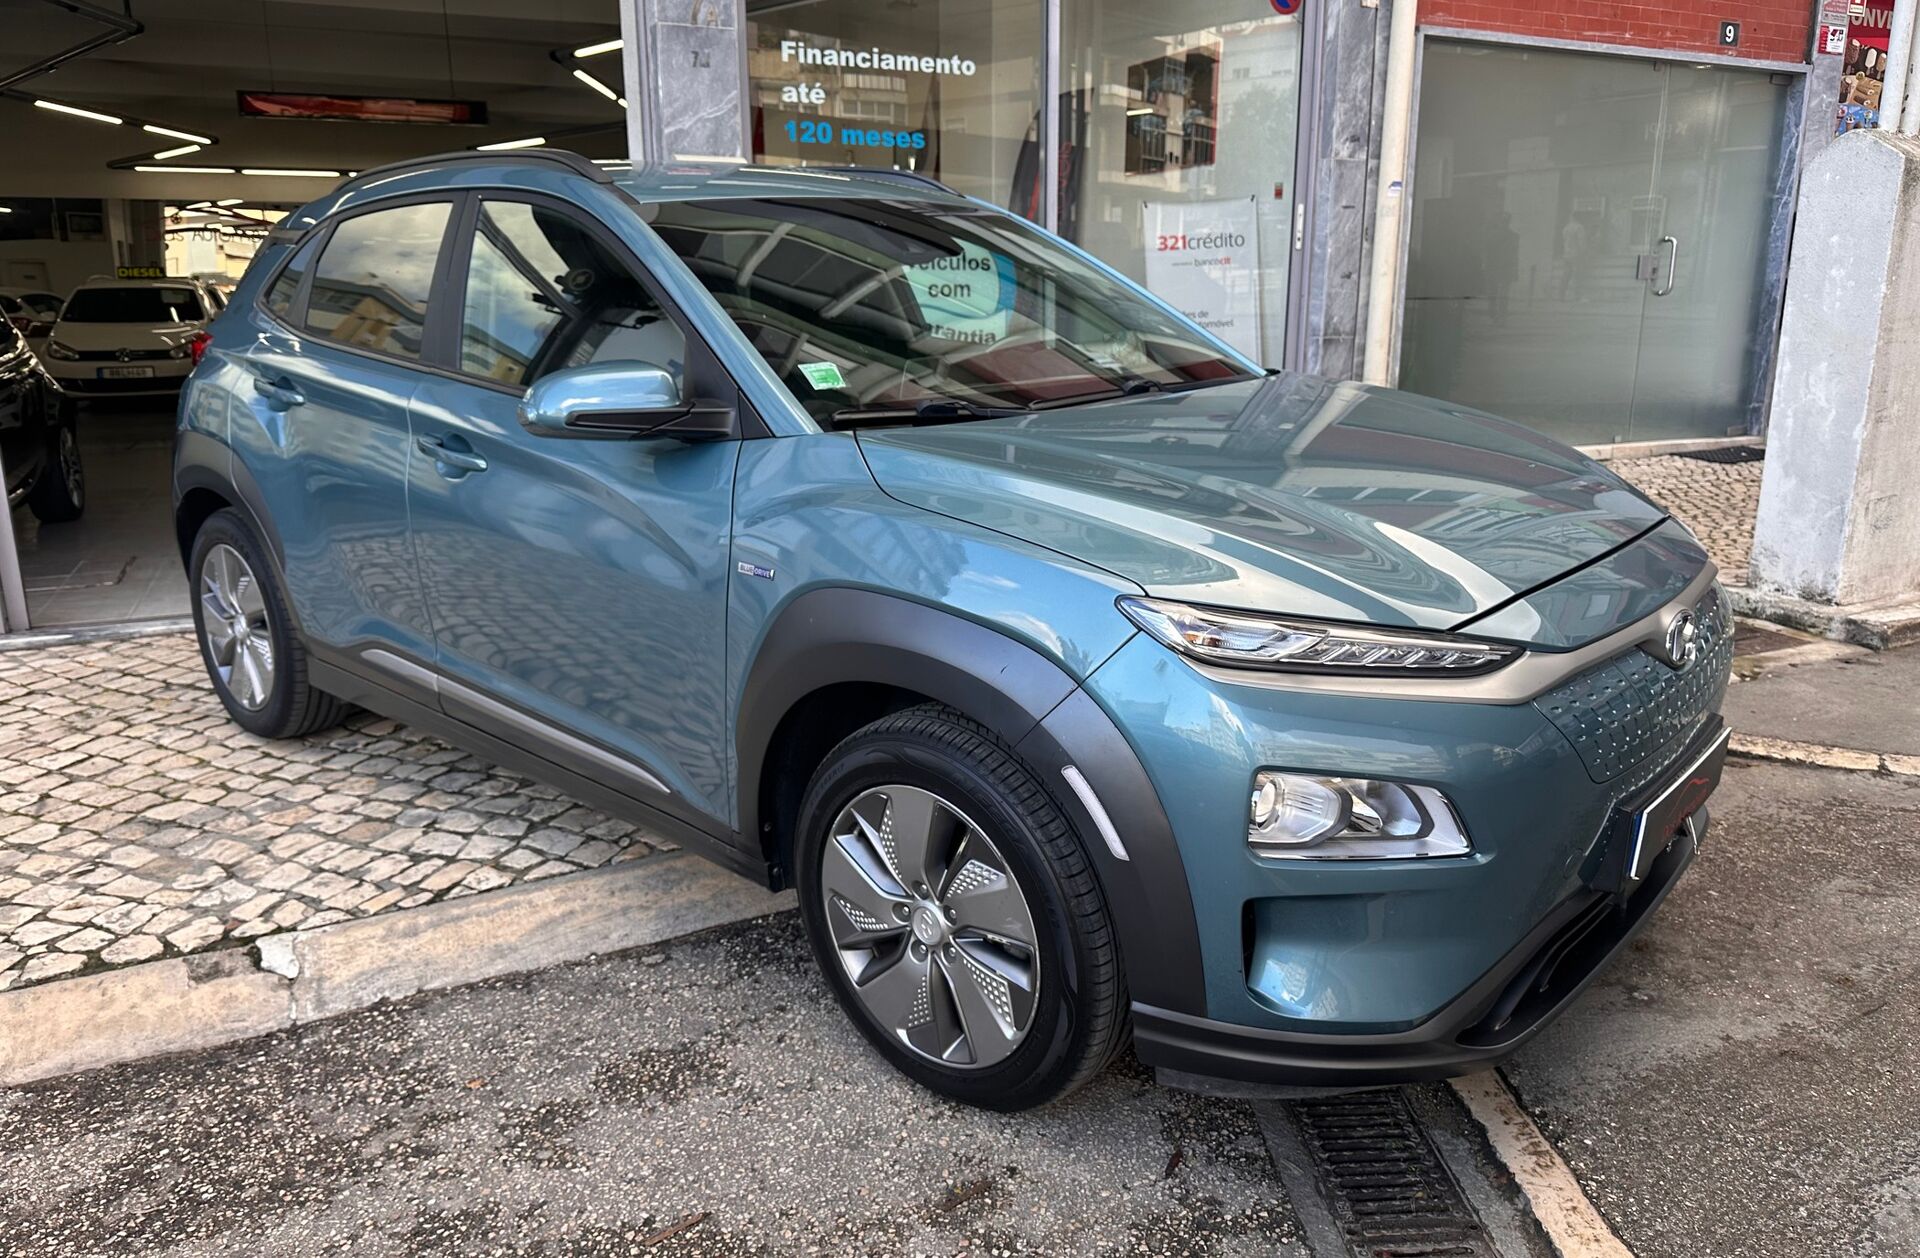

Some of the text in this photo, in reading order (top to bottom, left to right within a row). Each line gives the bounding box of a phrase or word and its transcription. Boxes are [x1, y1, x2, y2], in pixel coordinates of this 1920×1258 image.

[1850, 8, 1893, 29] ONV
[1725, 25, 1735, 43] 9
[780, 40, 977, 76] Financiamento
[781, 82, 826, 104] até
[784, 120, 926, 149] 120 meses
[1158, 232, 1246, 251] 321crédito
[117, 267, 163, 278] DIESEL
[928, 283, 971, 298] com
[928, 323, 997, 345] rantia
